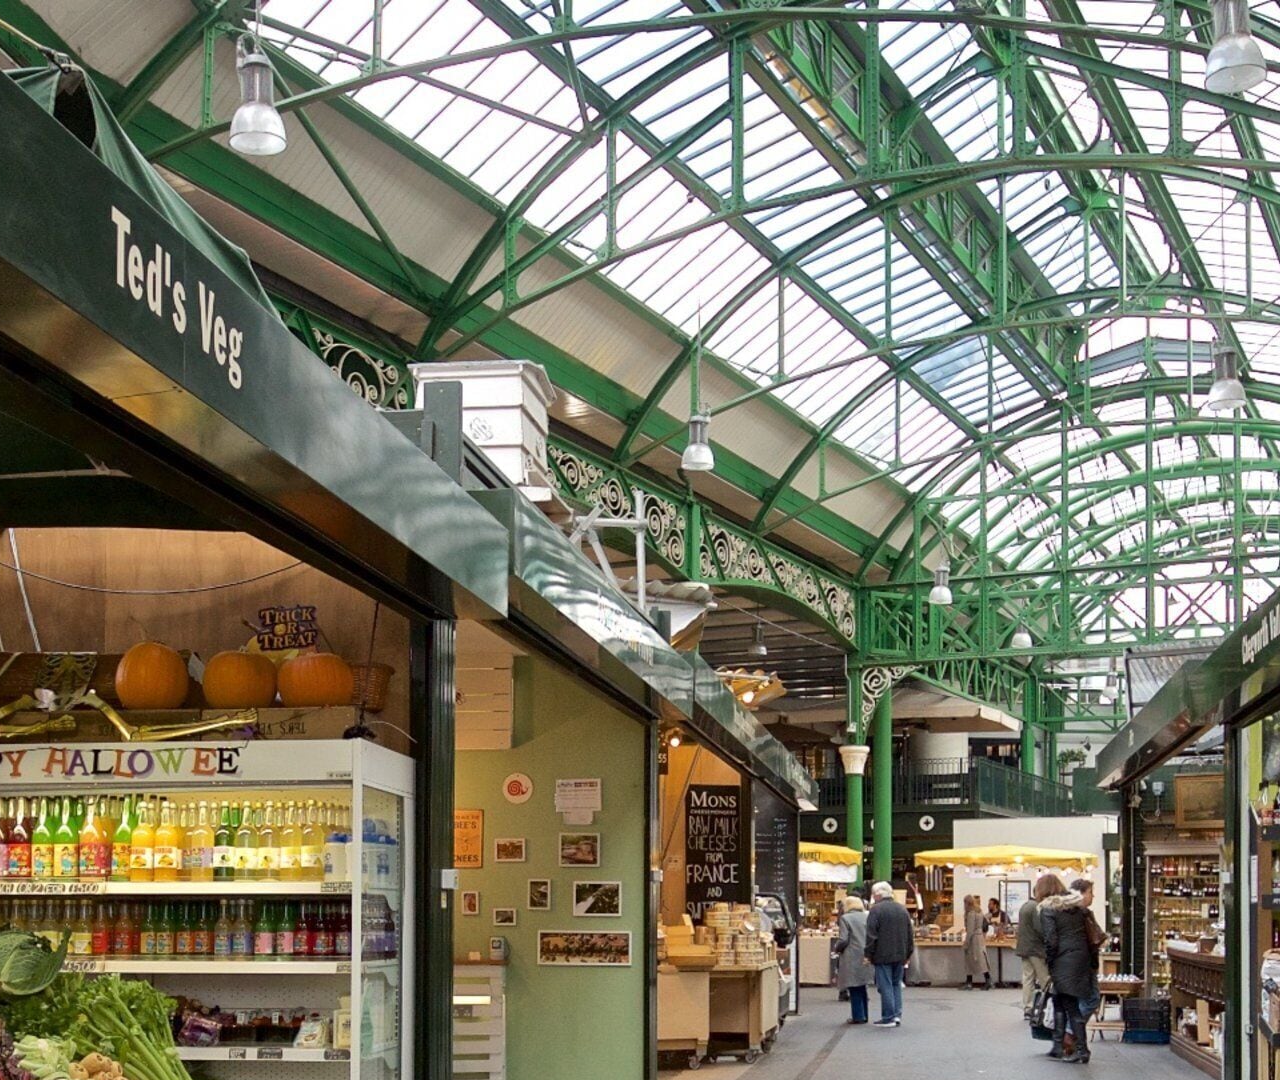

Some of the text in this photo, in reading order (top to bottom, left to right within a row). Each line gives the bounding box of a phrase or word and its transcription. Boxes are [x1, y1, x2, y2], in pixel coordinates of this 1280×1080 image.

[111, 205, 243, 389] Ted's Veg
[259, 606, 317, 626] TRICK
[260, 630, 318, 650] TREAT
[42, 747, 241, 778] HALLOWEE
[688, 816, 738, 836] RAW MILK
[687, 835, 737, 852] CHEESES
[705, 853, 724, 865] FROM
[686, 864, 739, 884] FRANCE
[706, 886, 722, 898] AND
